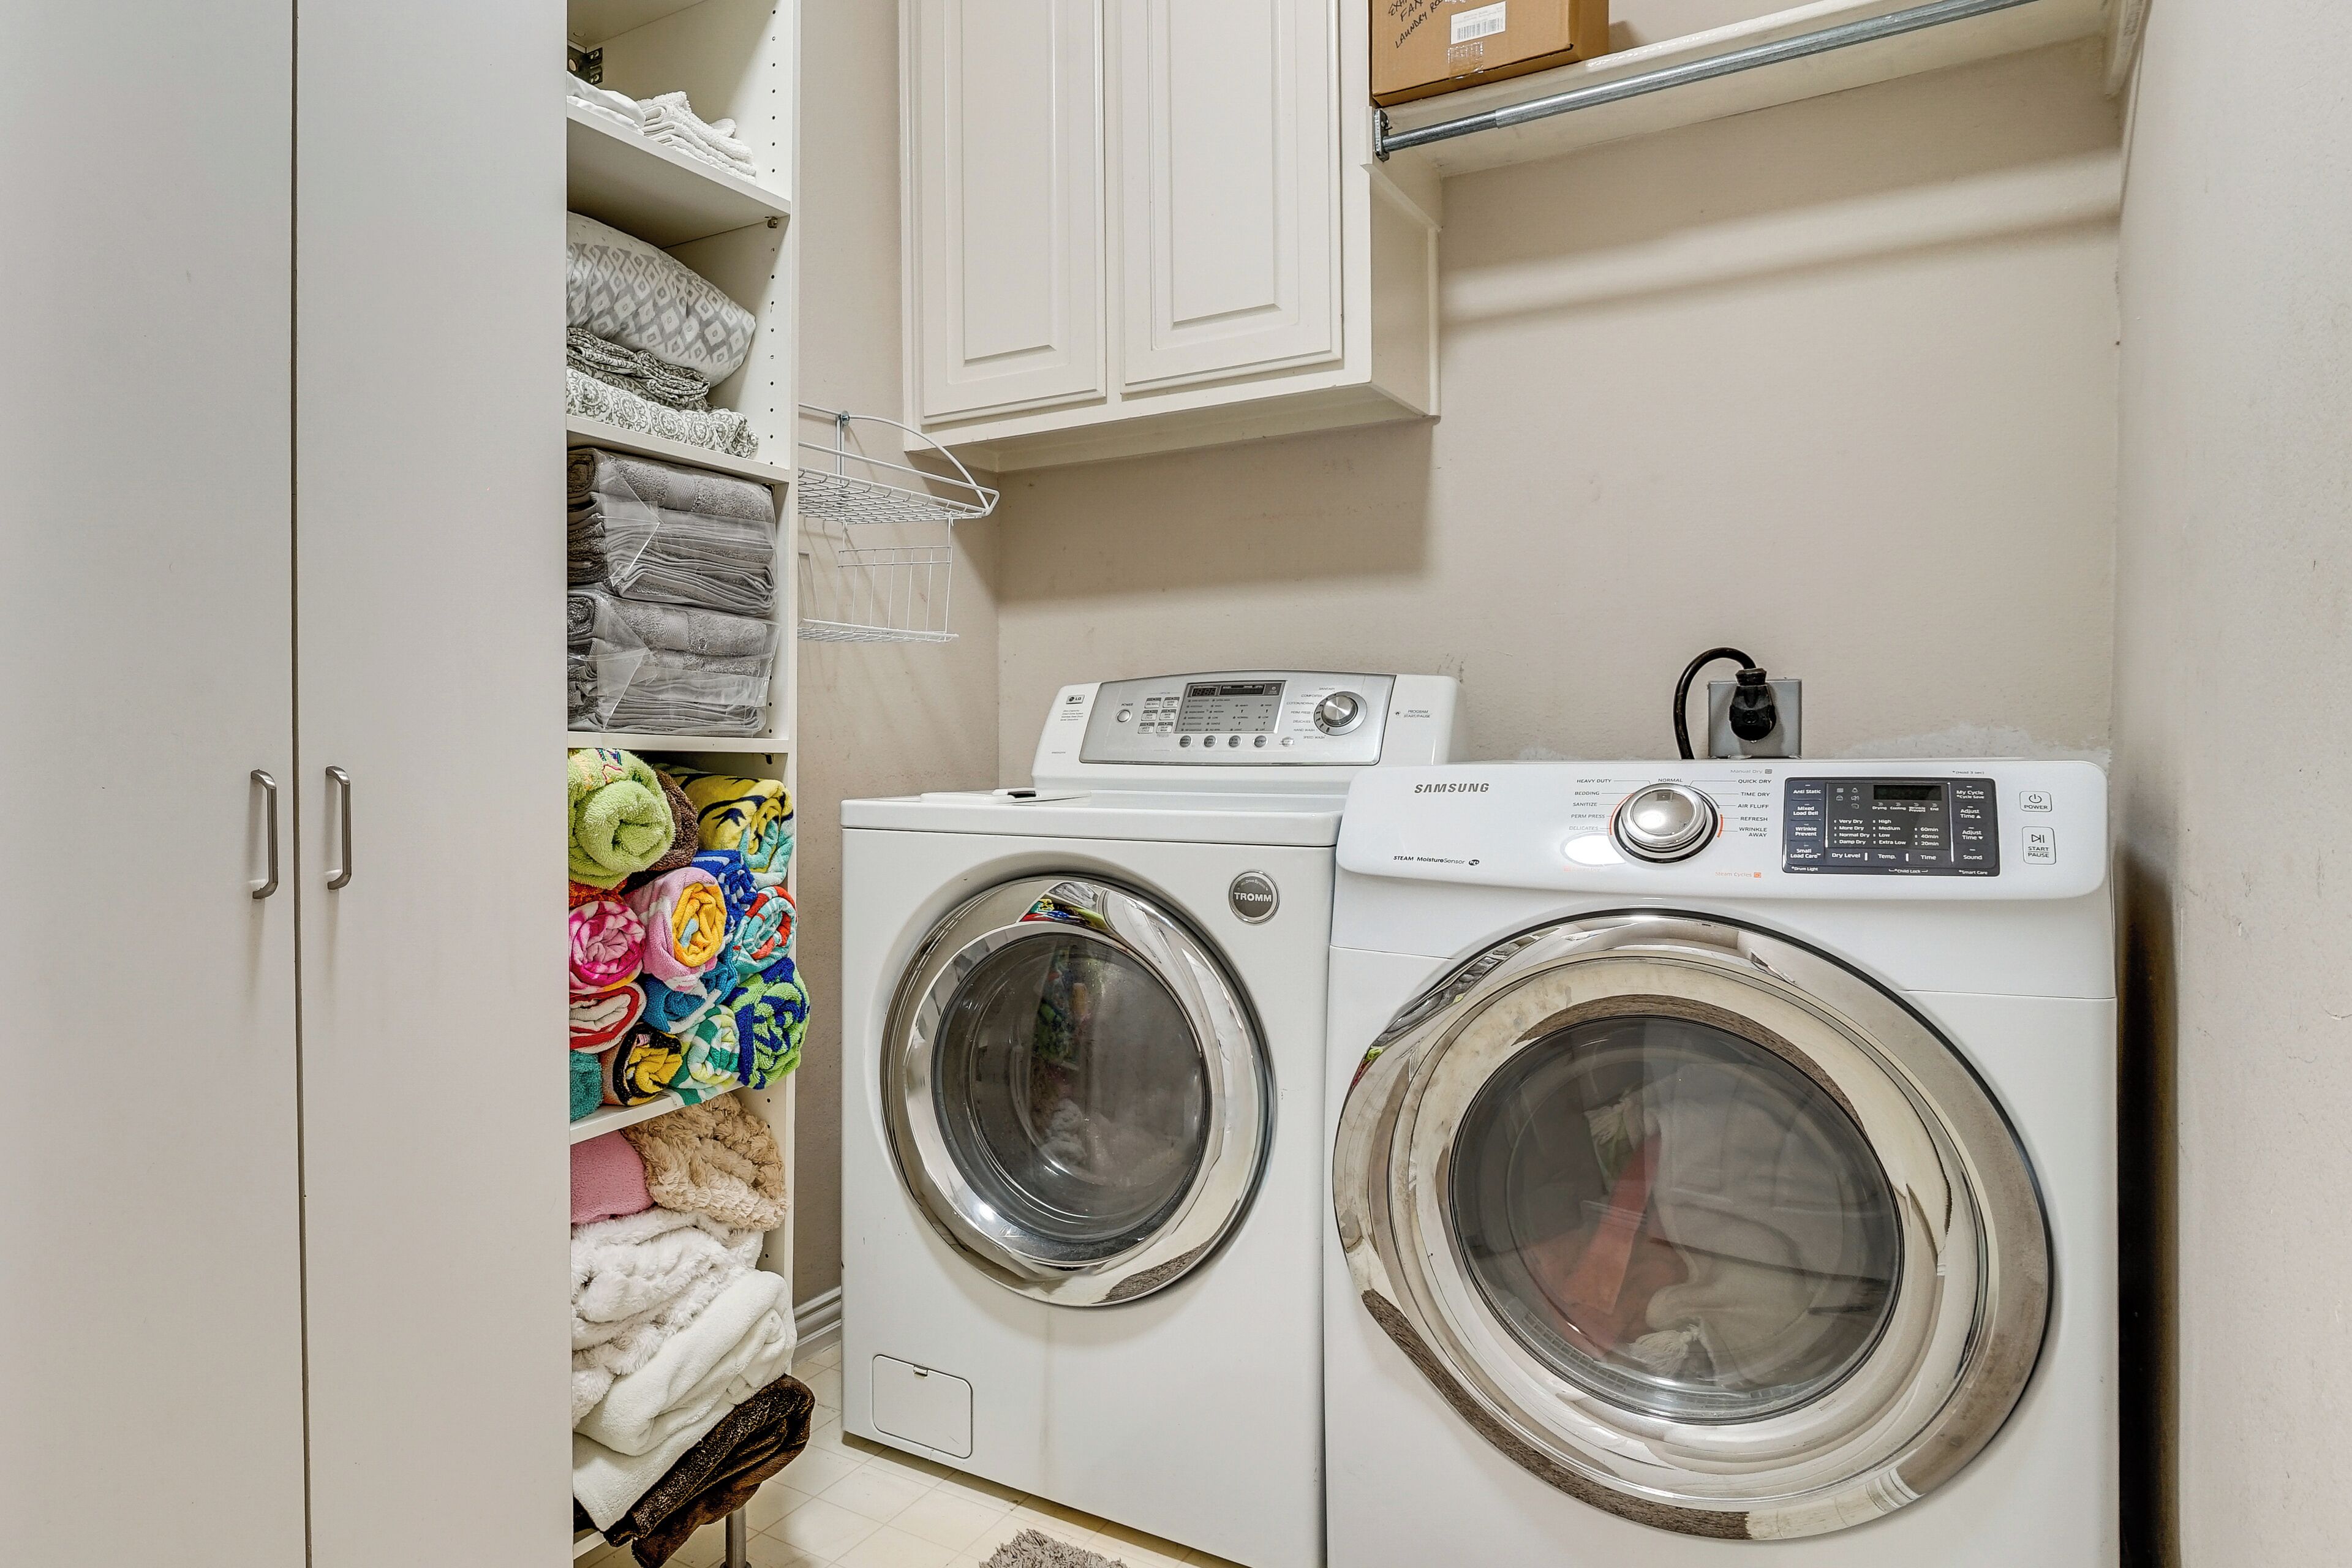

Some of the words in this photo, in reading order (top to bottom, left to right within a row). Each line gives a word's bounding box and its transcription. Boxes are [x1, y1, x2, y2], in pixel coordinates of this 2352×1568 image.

[1395, 12, 1427, 48] LAUNDRY
[1414, 783, 1490, 793] SAMSUNG
[1417, 856, 1466, 865] MoistureSensor
[1234, 892, 1272, 902] TROMM
